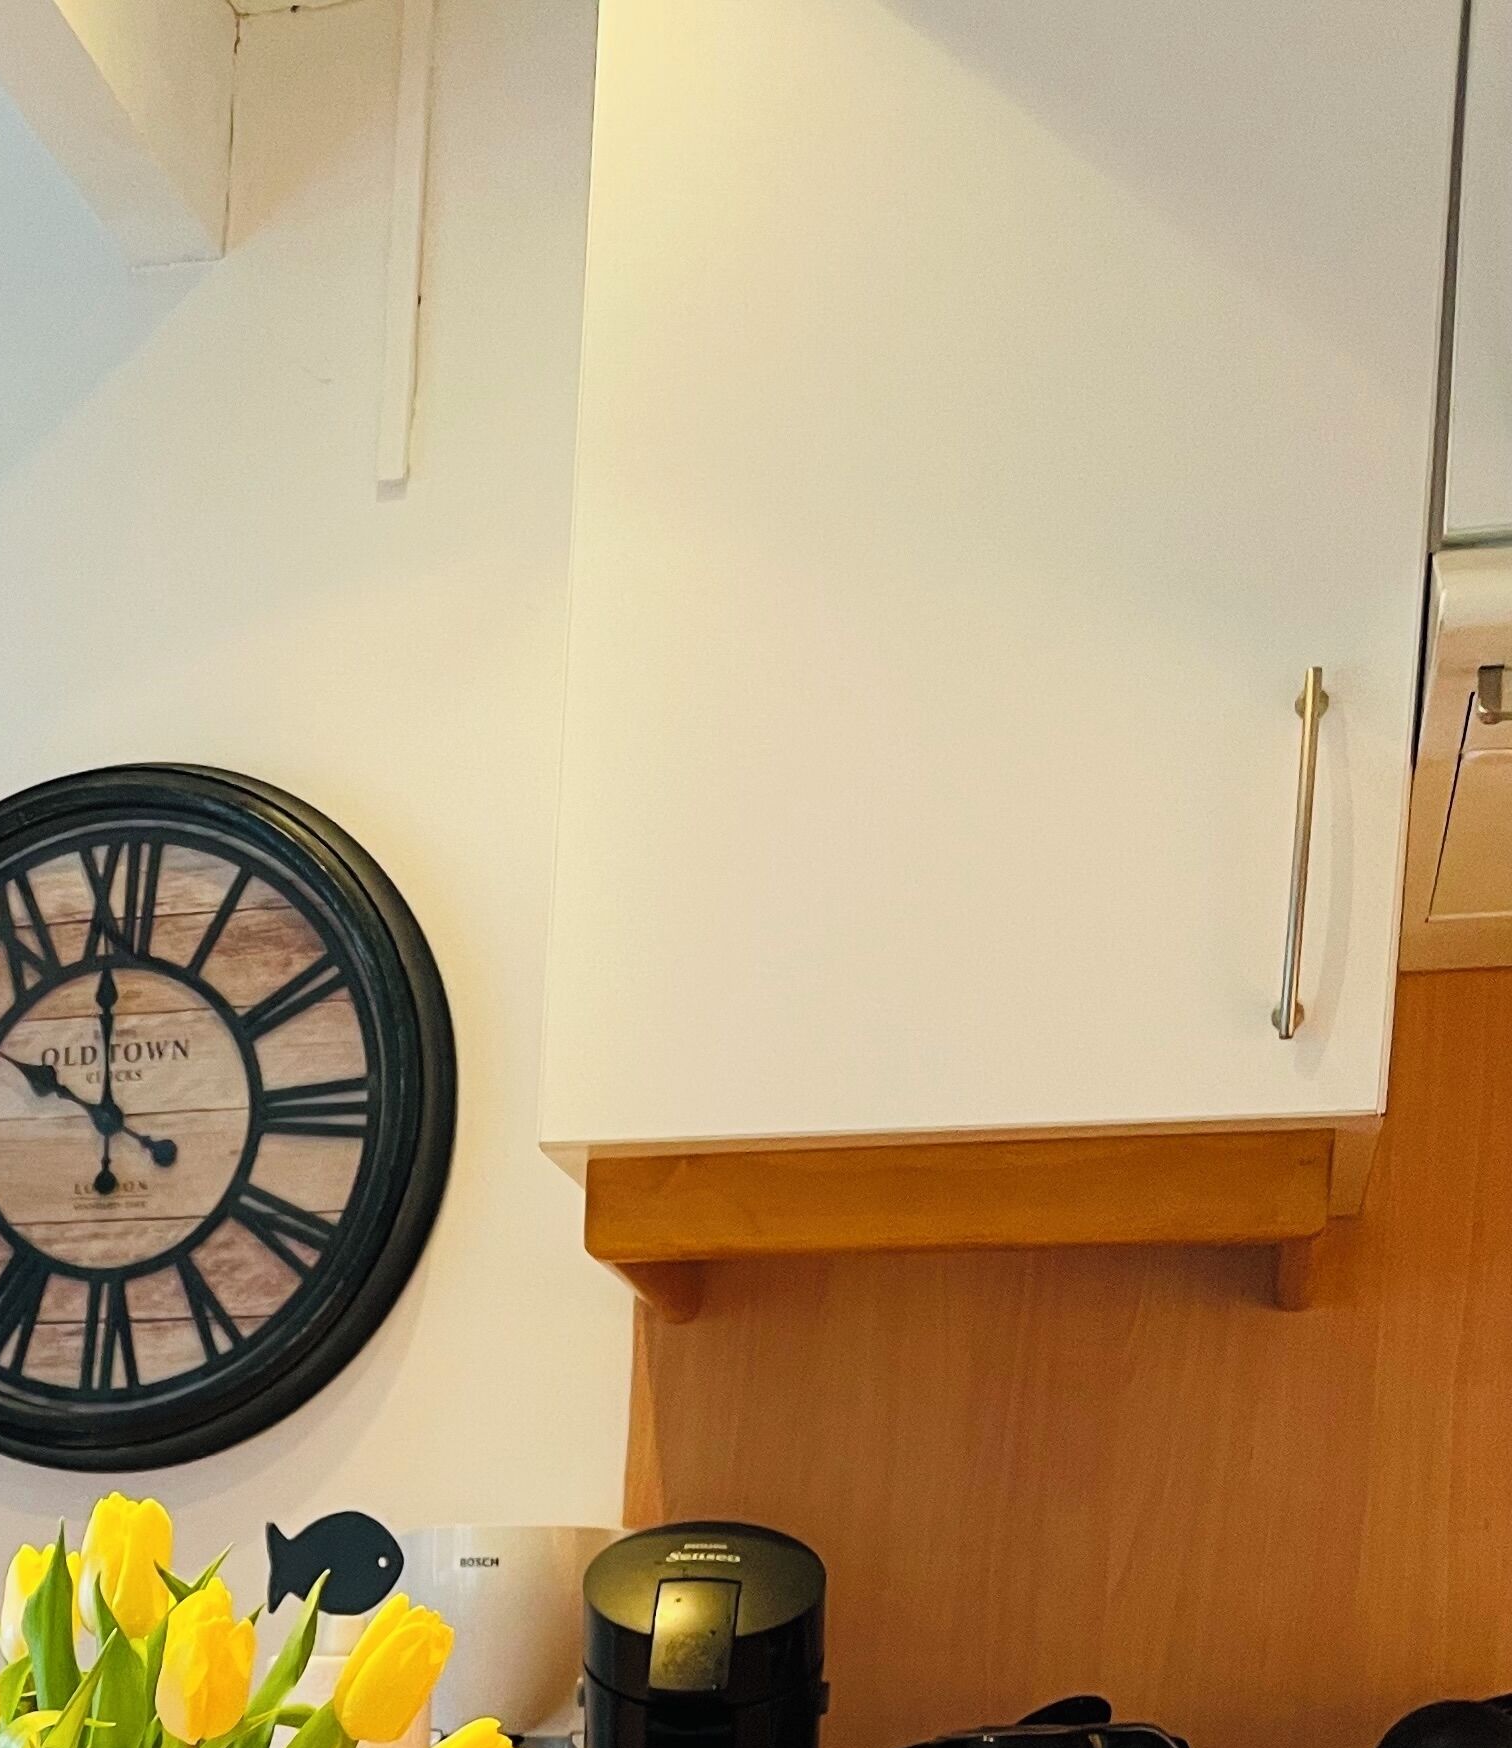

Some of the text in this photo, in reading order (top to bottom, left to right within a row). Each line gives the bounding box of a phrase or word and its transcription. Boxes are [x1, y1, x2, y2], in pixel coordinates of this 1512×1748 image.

[41, 1039, 190, 1067] OLD TOWN
[87, 1070, 141, 1084] CLCKS
[74, 1181, 148, 1195] LOON
[460, 1557, 499, 1568] BOSCH
